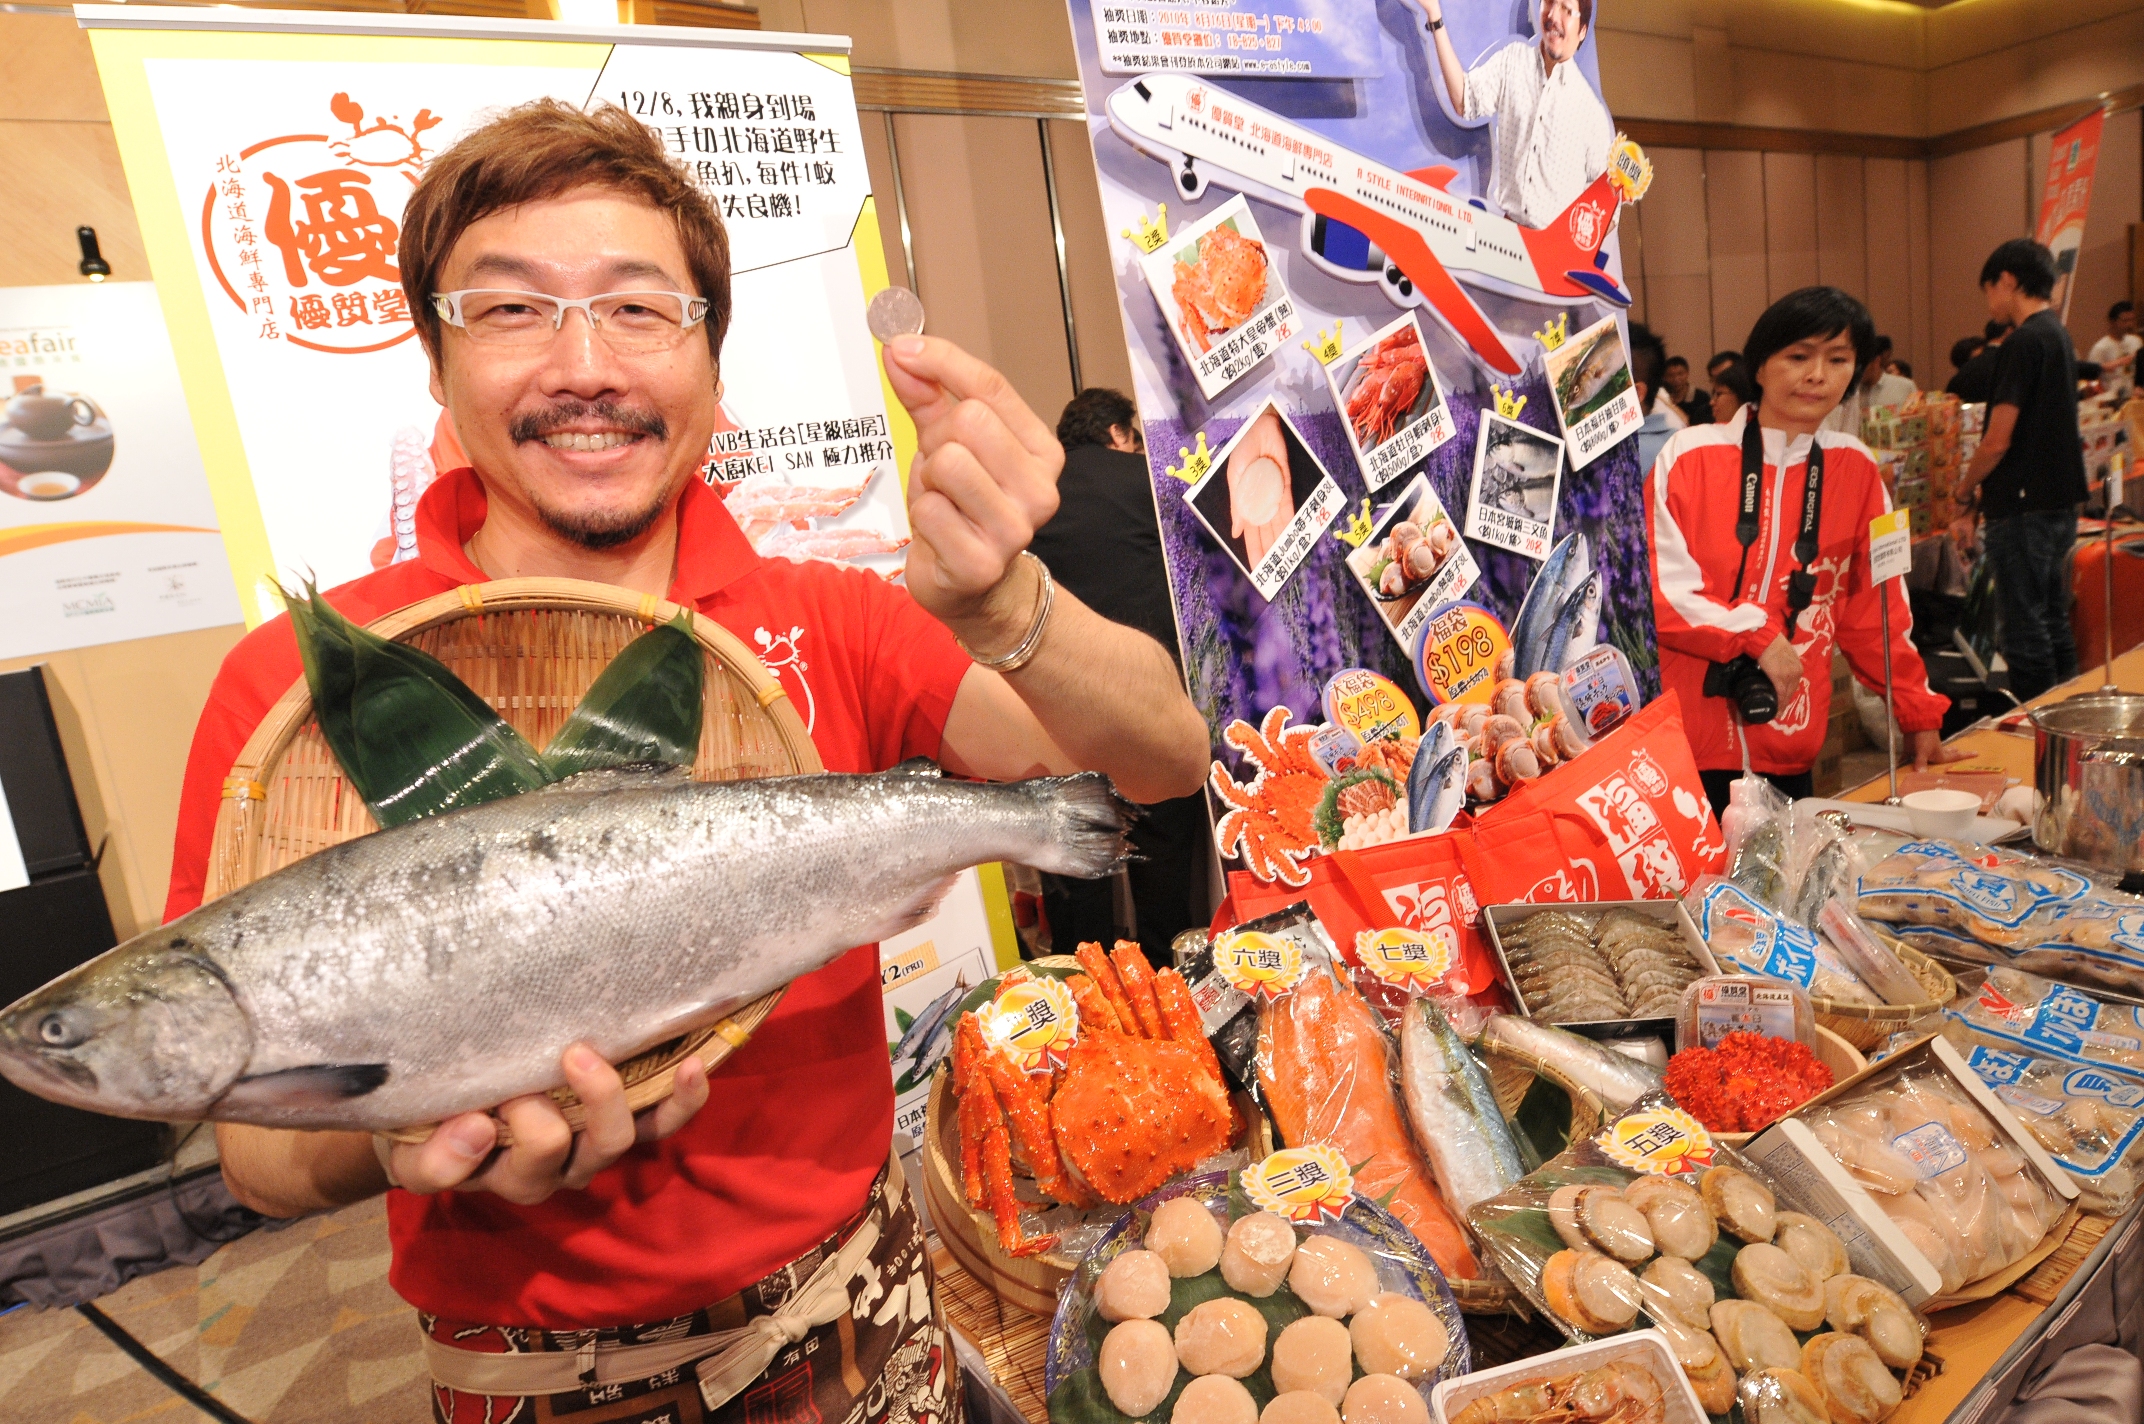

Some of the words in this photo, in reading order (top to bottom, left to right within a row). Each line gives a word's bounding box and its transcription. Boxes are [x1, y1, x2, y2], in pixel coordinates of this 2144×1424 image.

[1211, 103, 1245, 133] 優質堂
[1249, 120, 1334, 168] 北海道海鮮專門店
[1356, 166, 1363, 179] A
[1366, 171, 1392, 191] STYLE
[1395, 182, 1454, 217] INTERNATIONAL
[1457, 207, 1474, 224] LTD.
[263, 168, 401, 288] 優
[216, 153, 281, 341] 北海道海鮮專門店
[289, 287, 412, 332] 優質堂
[1274, 322, 1292, 343] 2名
[1430, 425, 1446, 446] 2名
[785, 450, 815, 470] SAN
[822, 440, 893, 468] 極力推介
[1745, 472, 1758, 513] Canon
[1808, 465, 1819, 489] EOS
[1315, 506, 1332, 527] 2名
[1803, 490, 1817, 534] DIGITAL
[1525, 537, 1543, 555] 20名
[1450, 575, 1468, 597] 10名
[1429, 606, 1469, 645] 福袋
[1427, 625, 1494, 689] $198
[1329, 669, 1377, 702] 大福袋
[1340, 689, 1396, 729] $498
[1232, 947, 1283, 970] 六獎
[1377, 943, 1430, 961] 七獎
[1009, 998, 1059, 1042] 一獎
[911, 1121, 926, 1139] 原
[1623, 1121, 1686, 1157] 五獎
[1266, 1161, 1330, 1197] 三獎
